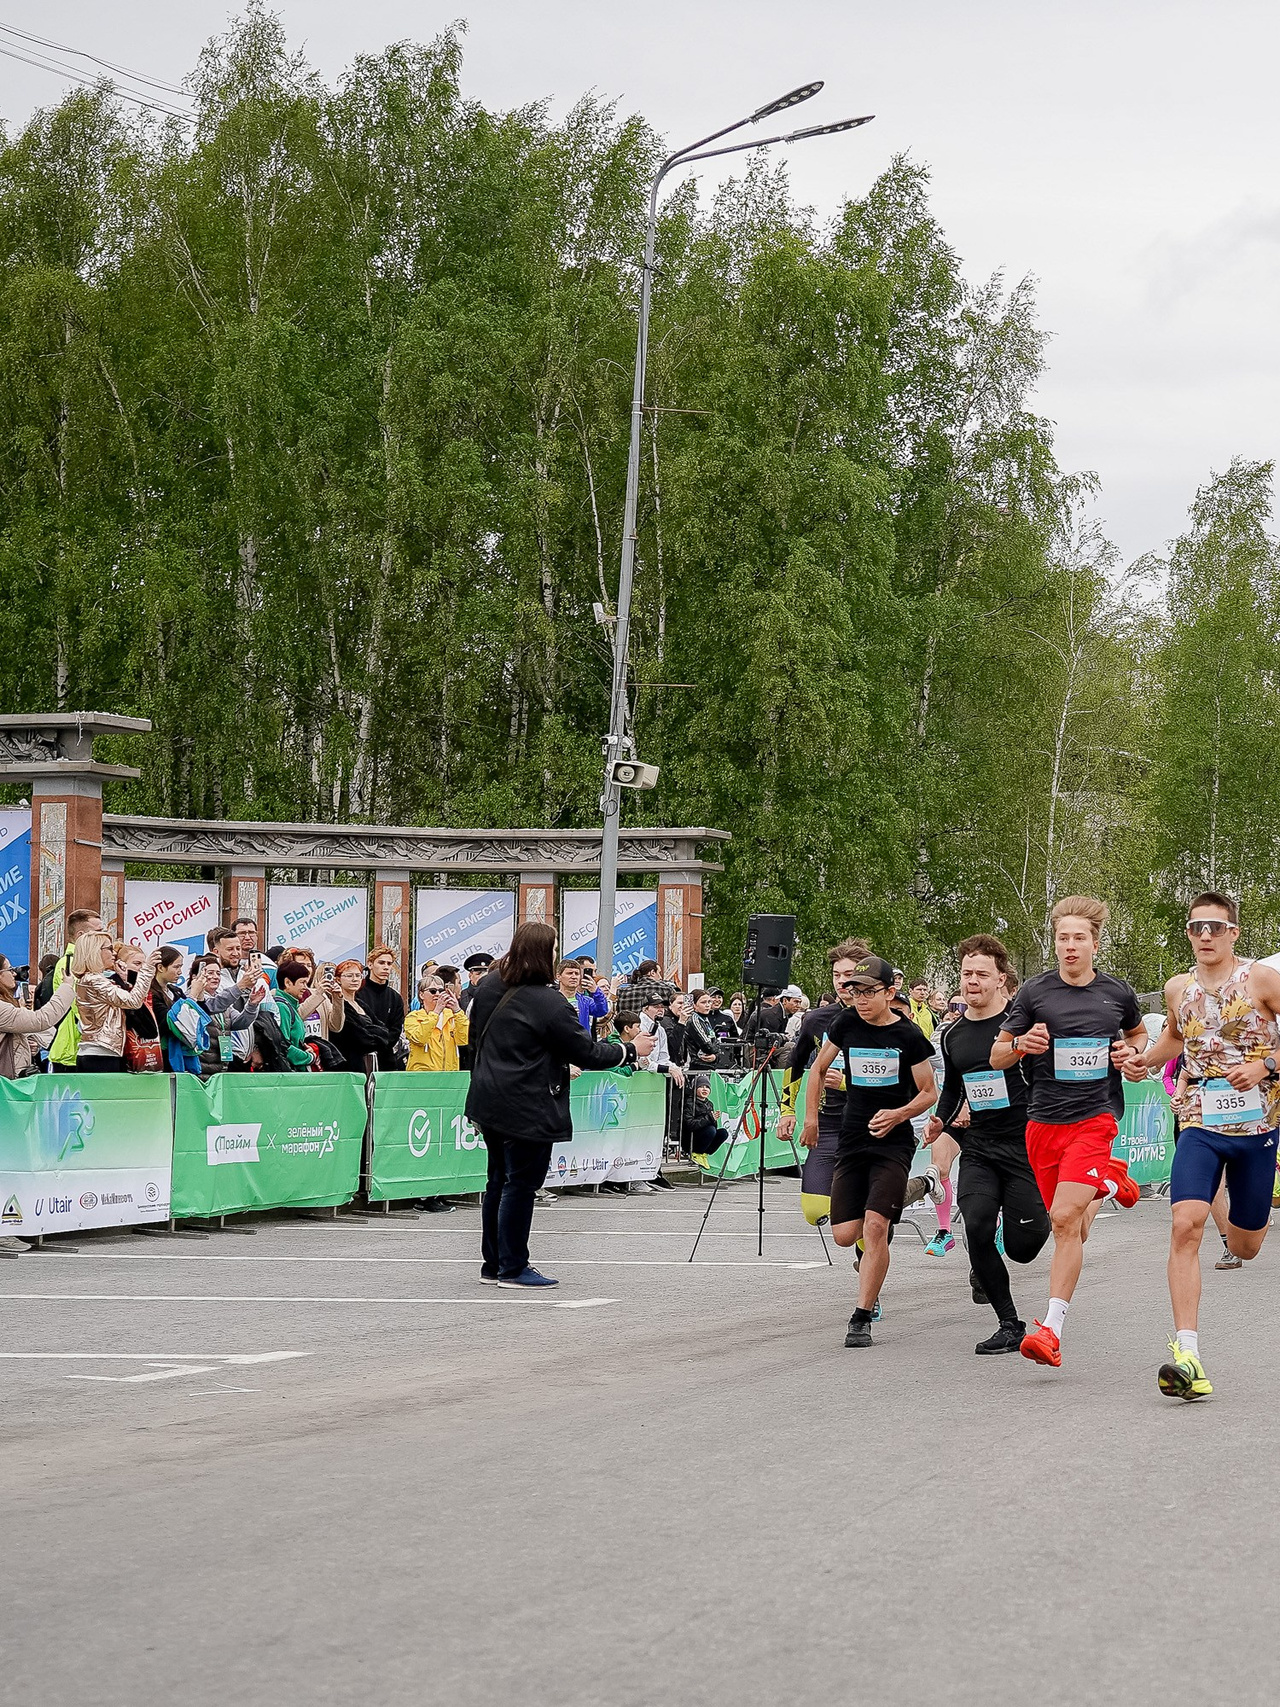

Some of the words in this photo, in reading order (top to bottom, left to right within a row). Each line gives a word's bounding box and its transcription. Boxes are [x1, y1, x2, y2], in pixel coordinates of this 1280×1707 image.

[134, 900, 175, 927] БЫТЬ
[143, 895, 211, 942] РОССИЕЙ
[276, 934, 286, 945] В
[289, 895, 358, 940] ДВИЖЕНИИ
[283, 899, 325, 925] БЫТЬ
[423, 927, 457, 948] БЫТЬ
[457, 899, 506, 930] ВМЕСТЕ
[450, 943, 482, 964] БЫТЬ
[862, 1065, 887, 1075] 3359
[1070, 1055, 1098, 1066] 3347
[971, 1087, 995, 1098] 3332
[1216, 1096, 1246, 1109] 3355
[287, 1121, 323, 1138] зелёный
[450, 1115, 487, 1150] 18
[281, 1138, 320, 1156] марафон
[48, 1196, 73, 1214] Utair
